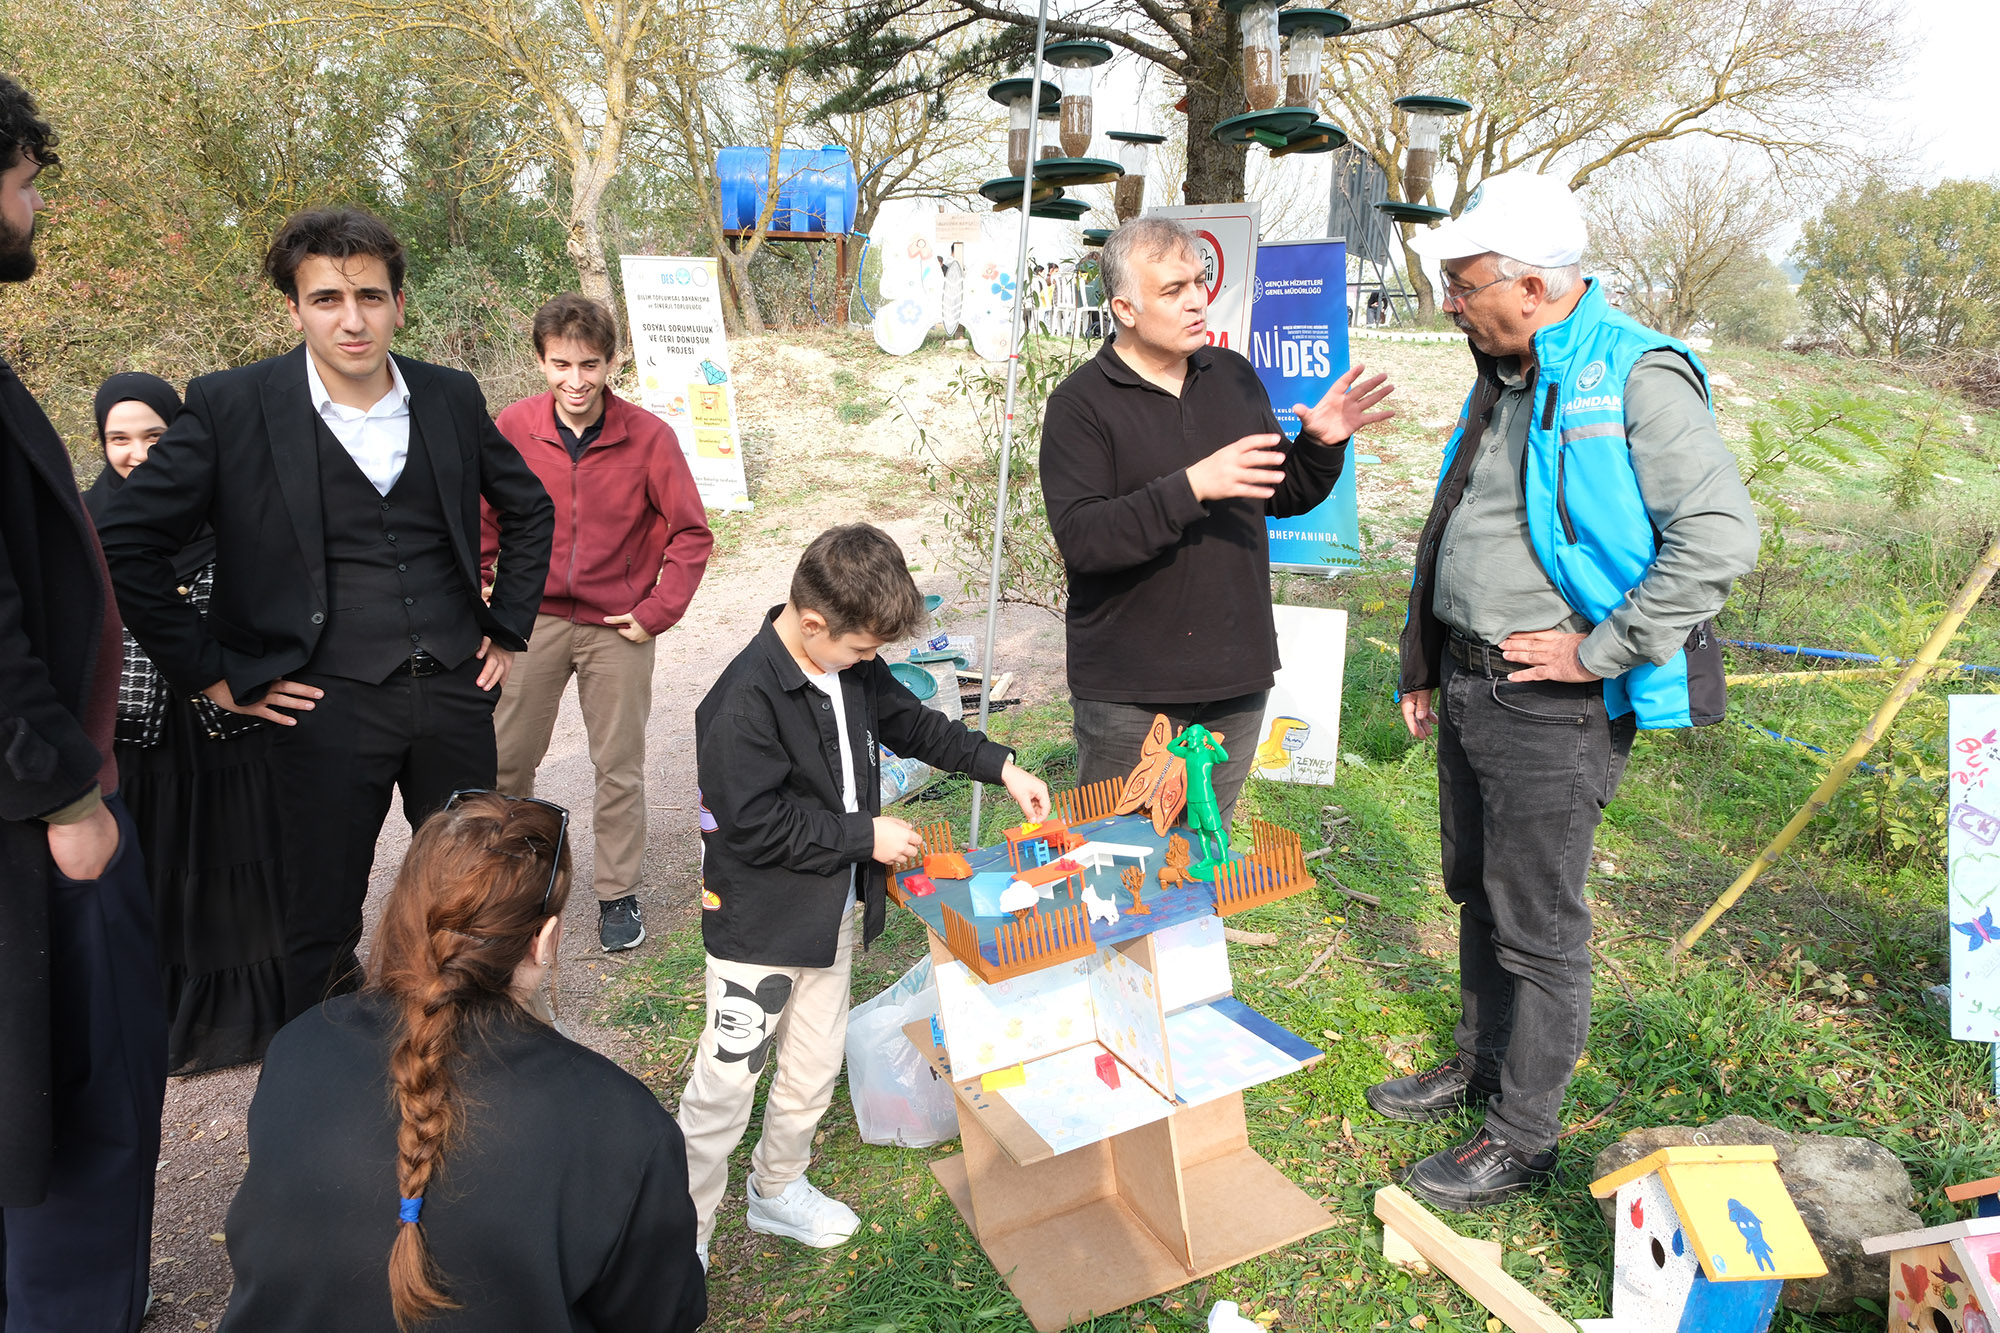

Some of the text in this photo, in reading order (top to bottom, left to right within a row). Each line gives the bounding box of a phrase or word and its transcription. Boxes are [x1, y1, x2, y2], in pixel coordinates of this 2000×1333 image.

[1265, 278, 1323, 288] GENÇLİK HİZMETLERİ
[1284, 287, 1322, 295] MÜDÜRLÜĞÜ
[642, 323, 713, 334] SOSYAL SORUMLULUK
[649, 334, 657, 342] VE
[667, 345, 694, 354] PROJESİ
[1253, 325, 1330, 378] NİDES
[1269, 530, 1338, 542] BHEPYANINDA
[1296, 756, 1332, 769] ZEYNEP
